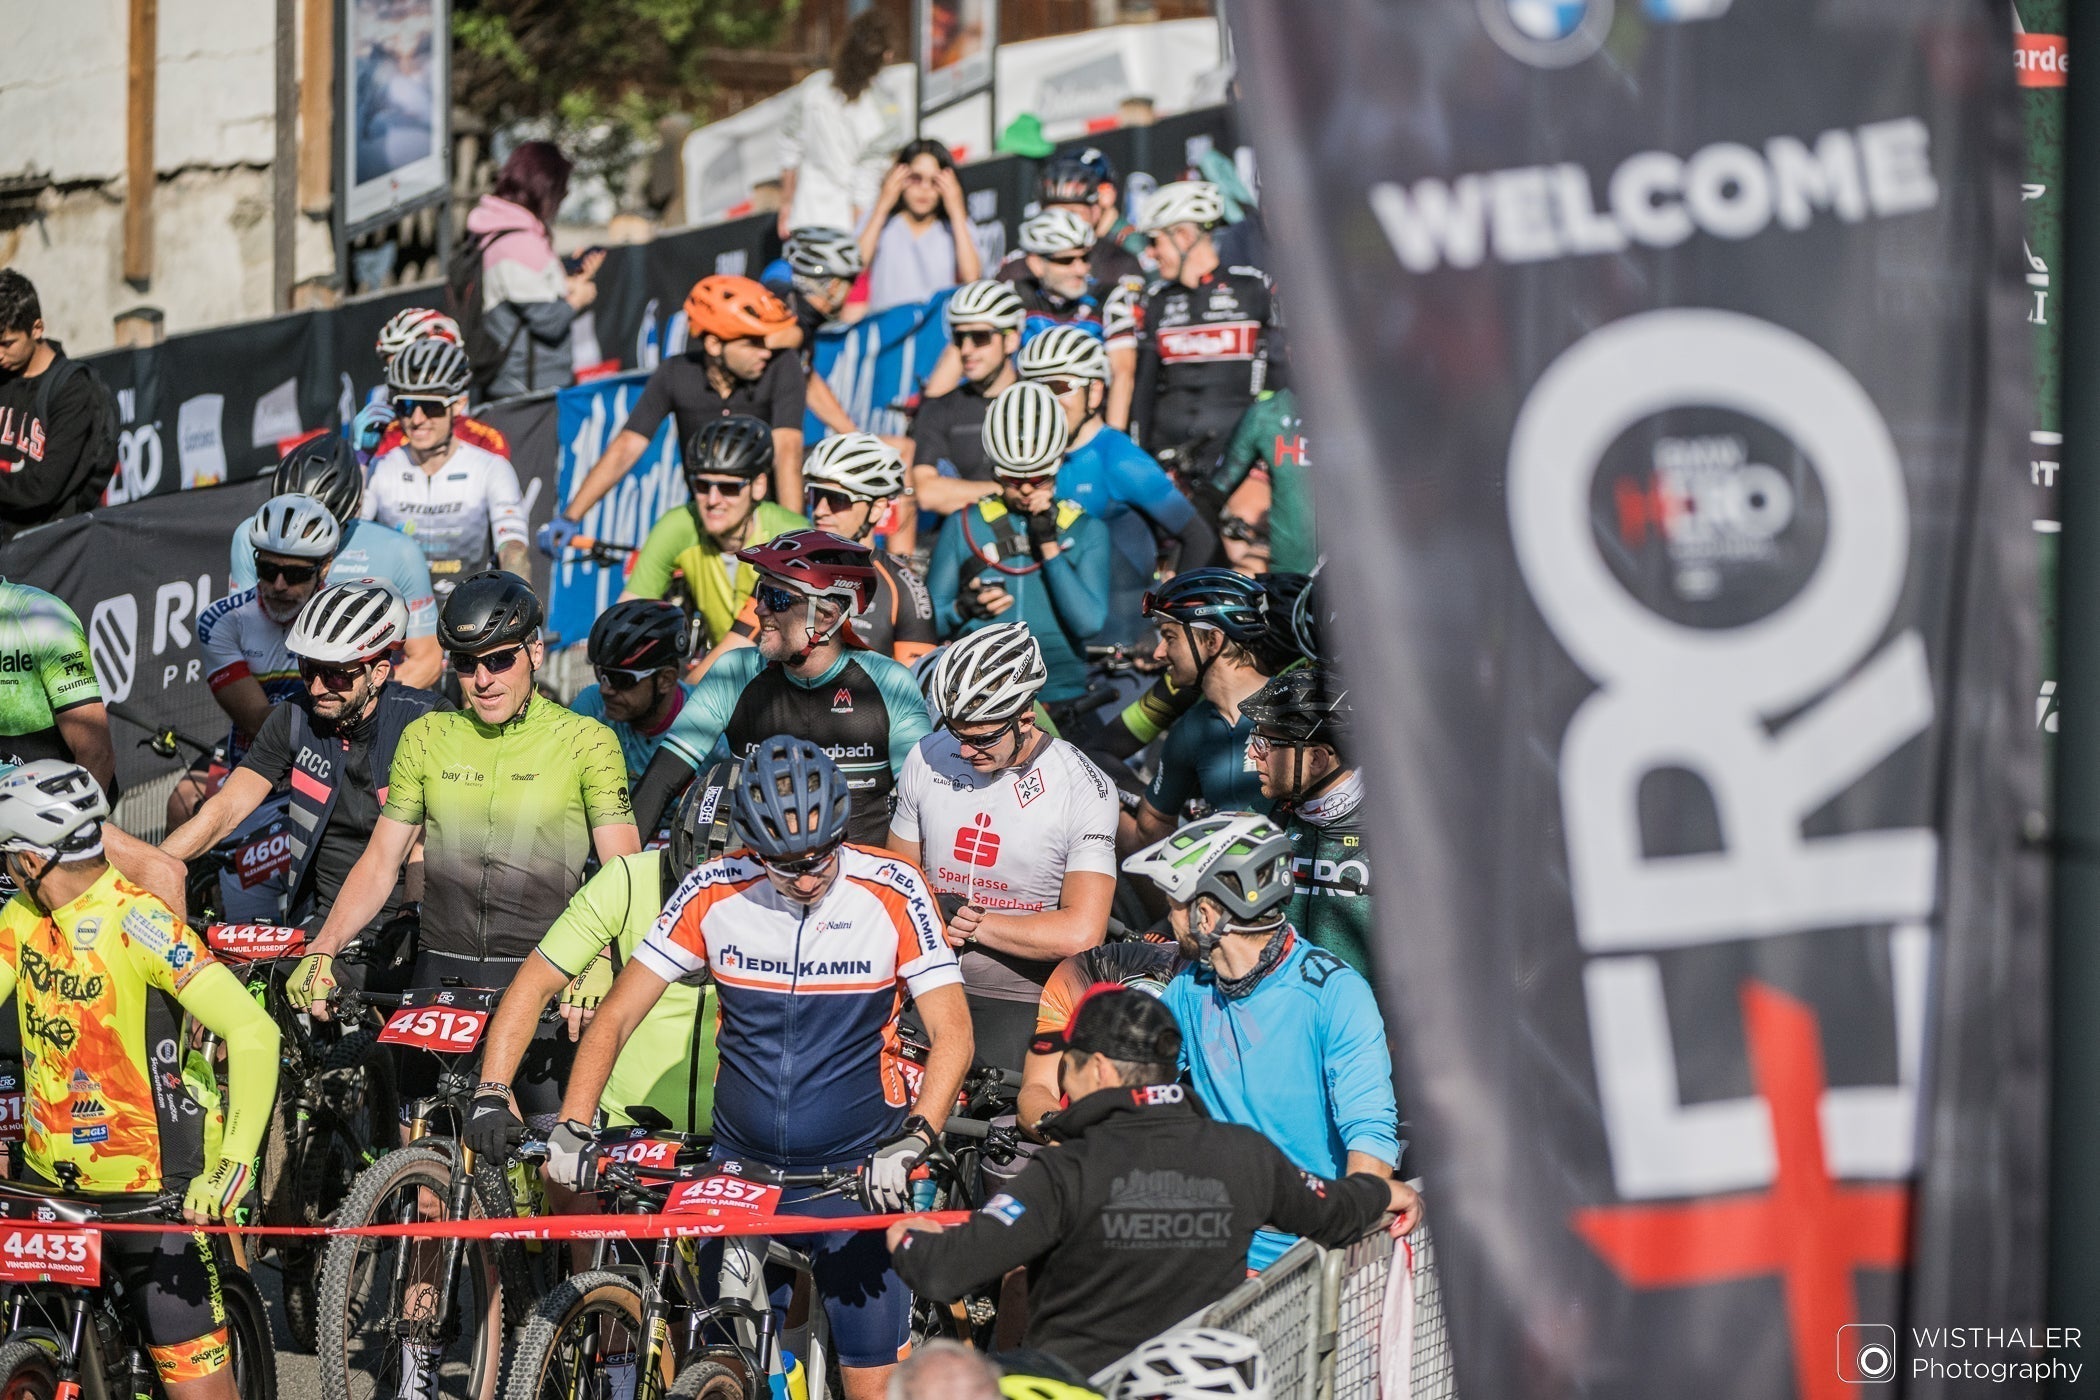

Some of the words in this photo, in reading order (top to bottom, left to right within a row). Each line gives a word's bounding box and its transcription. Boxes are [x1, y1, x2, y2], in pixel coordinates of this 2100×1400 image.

[1368, 116, 1939, 273] WELCOME
[0, 405, 46, 462] LLS
[834, 579, 862, 590] 100%
[0, 649, 34, 673] ale
[64, 661, 87, 677] FOX
[57, 675, 98, 694] SHIMANO
[295, 745, 332, 780] RCC
[933, 777, 951, 786] KLAUS
[1197, 834, 1239, 874] ENDURA
[938, 867, 1009, 892] Sparkasse
[1290, 856, 1371, 897] ERO
[973, 892, 1043, 913] Sauerland
[217, 925, 294, 944] 4429
[826, 920, 852, 930] Nalini
[222, 944, 252, 953] MANUEL
[302, 956, 319, 993] CASTELLI
[746, 957, 872, 977] EDILKAMIN
[388, 1010, 480, 1043] 4512
[1131, 1083, 1185, 1107] HERO
[9, 1122, 25, 1131] MÜL
[90, 1126, 107, 1136] GLS
[603, 1142, 668, 1163] 504
[681, 1178, 767, 1202] 4557
[679, 1197, 716, 1206] ROBERTO
[718, 1199, 759, 1210] PARNETTI
[1101, 1212, 1233, 1240] WEROCK
[3, 1231, 87, 1263] 4433
[5, 1260, 46, 1269] VINCENZO
